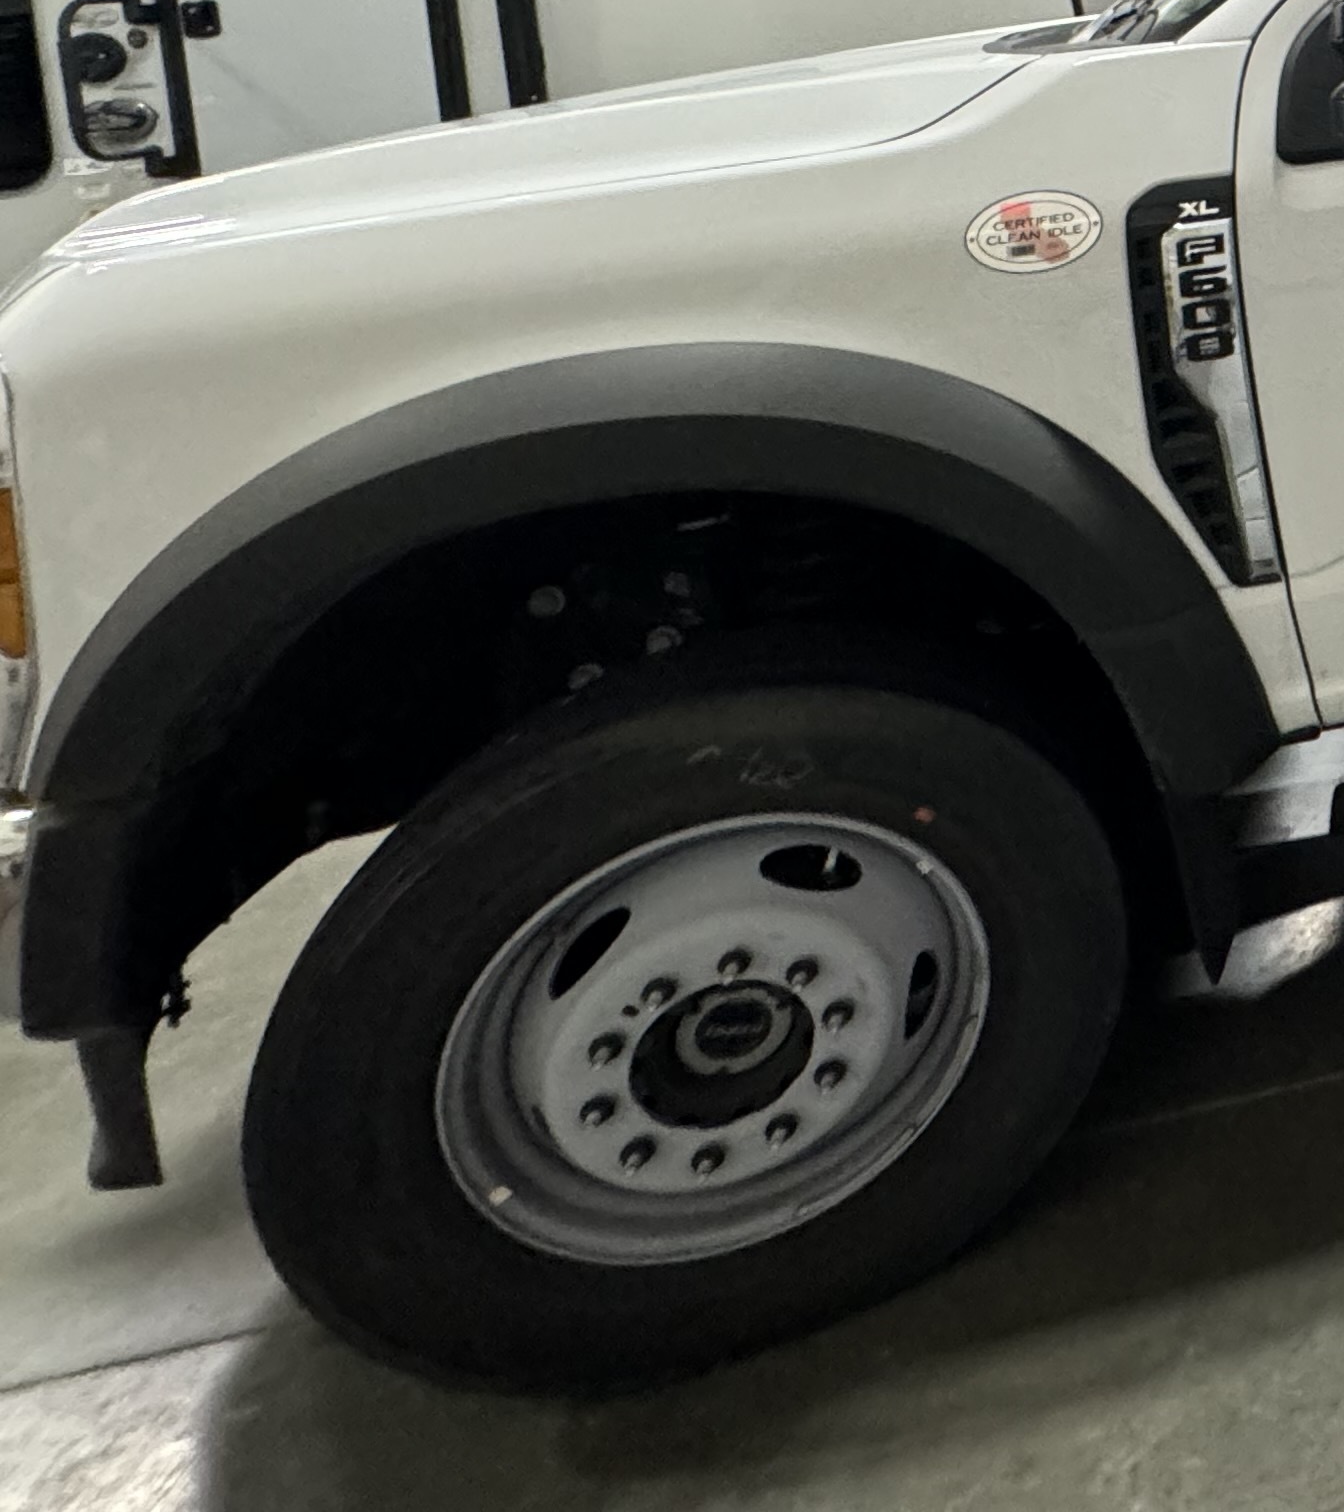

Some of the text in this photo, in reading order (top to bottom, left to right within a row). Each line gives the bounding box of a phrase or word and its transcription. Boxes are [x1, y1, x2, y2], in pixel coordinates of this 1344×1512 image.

[1178, 200, 1220, 219] XL
[992, 212, 1075, 233] CERTIFIED
[986, 224, 1083, 247] CLEAN IDLE
